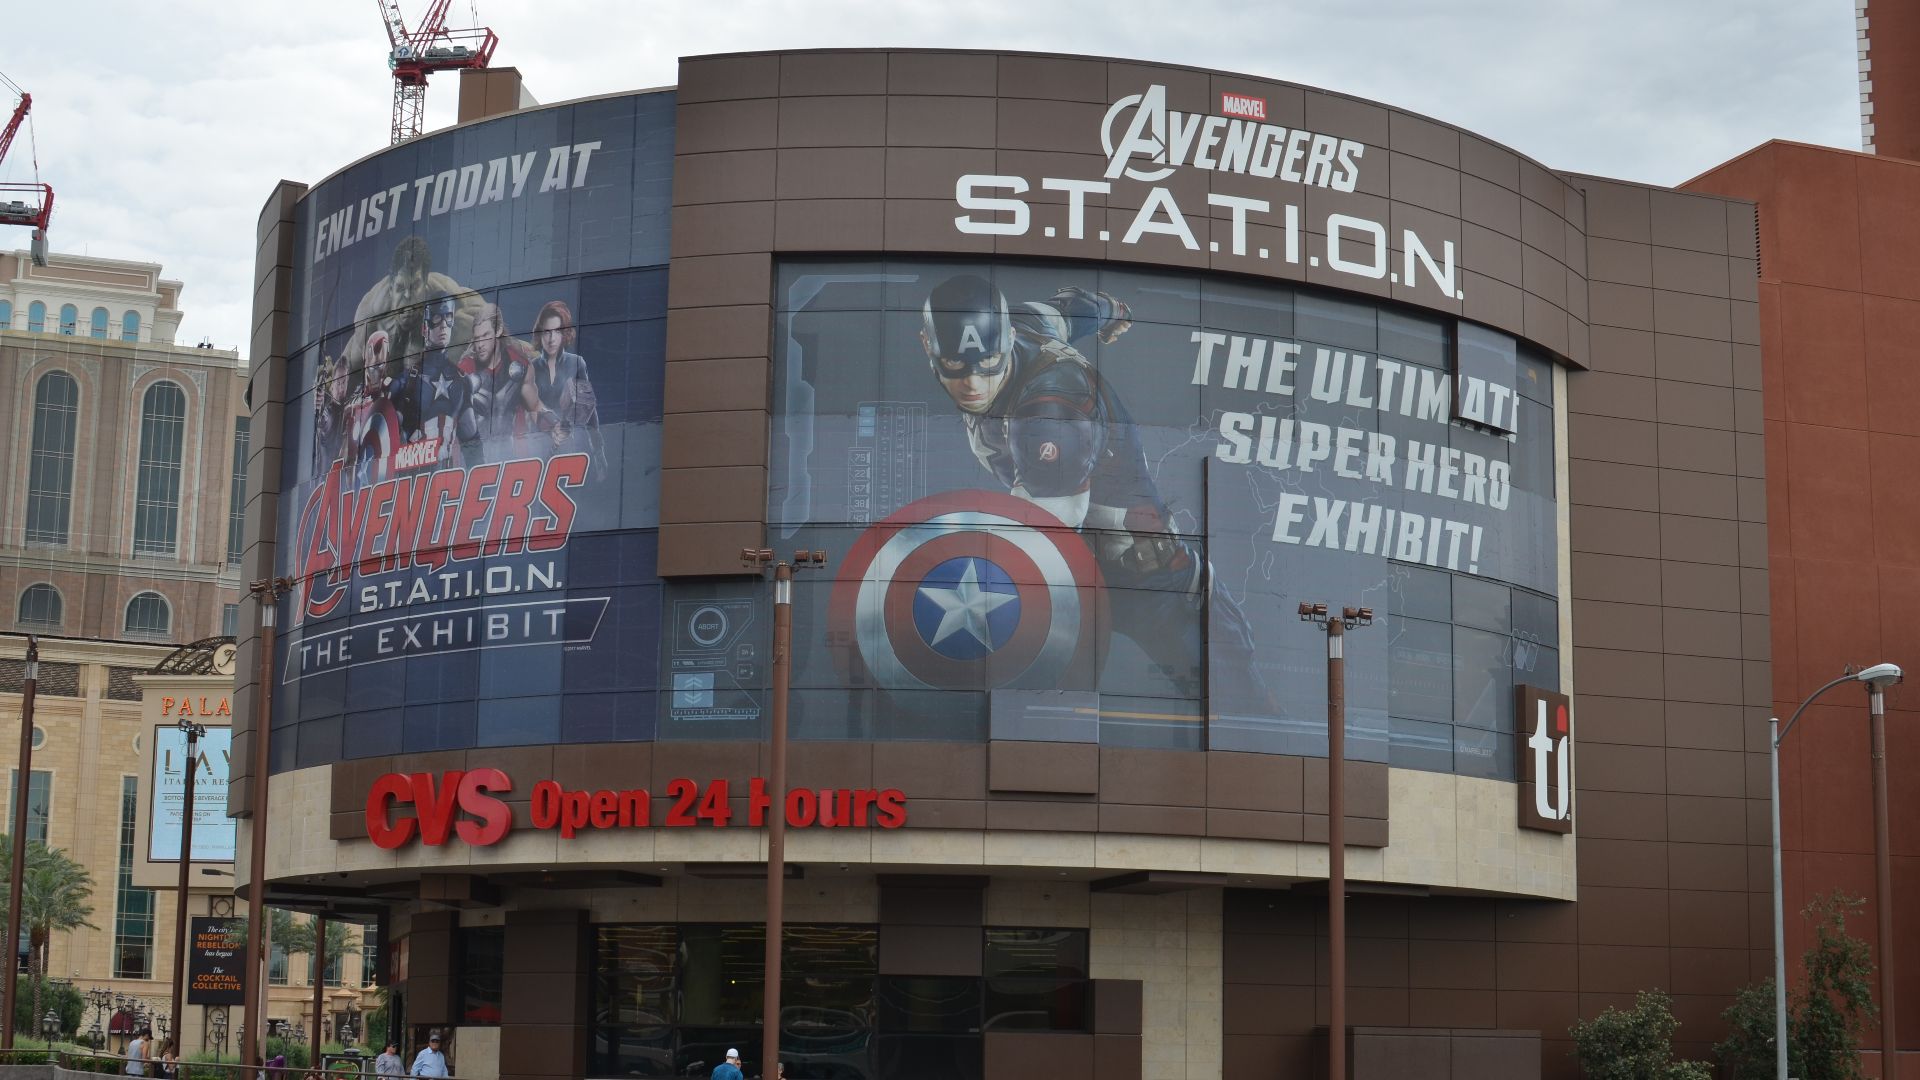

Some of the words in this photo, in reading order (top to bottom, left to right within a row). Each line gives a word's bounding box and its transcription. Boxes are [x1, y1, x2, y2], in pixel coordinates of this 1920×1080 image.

[1100, 84, 1364, 194] AVENGERS
[1223, 95, 1265, 119] MARVEL
[314, 183, 408, 264] ENLIST
[412, 151, 536, 222] TODAY
[540, 141, 602, 193] AT
[955, 174, 1464, 300] S.T.A.T.I.O.N.
[1190, 331, 1301, 396] THE
[395, 439, 439, 469] MARVEL
[1216, 412, 1396, 486] SUPER
[1405, 440, 1511, 511] HERO
[295, 453, 590, 626] AVENGERS
[1272, 492, 1483, 576] EXHIBIT!
[360, 561, 563, 614] S.T.A.T.I.O.N.
[300, 635, 353, 671] THE
[378, 608, 566, 655] EXHIBIT
[365, 768, 512, 849] CVS
[530, 779, 650, 838] Open
[666, 778, 732, 827] 24
